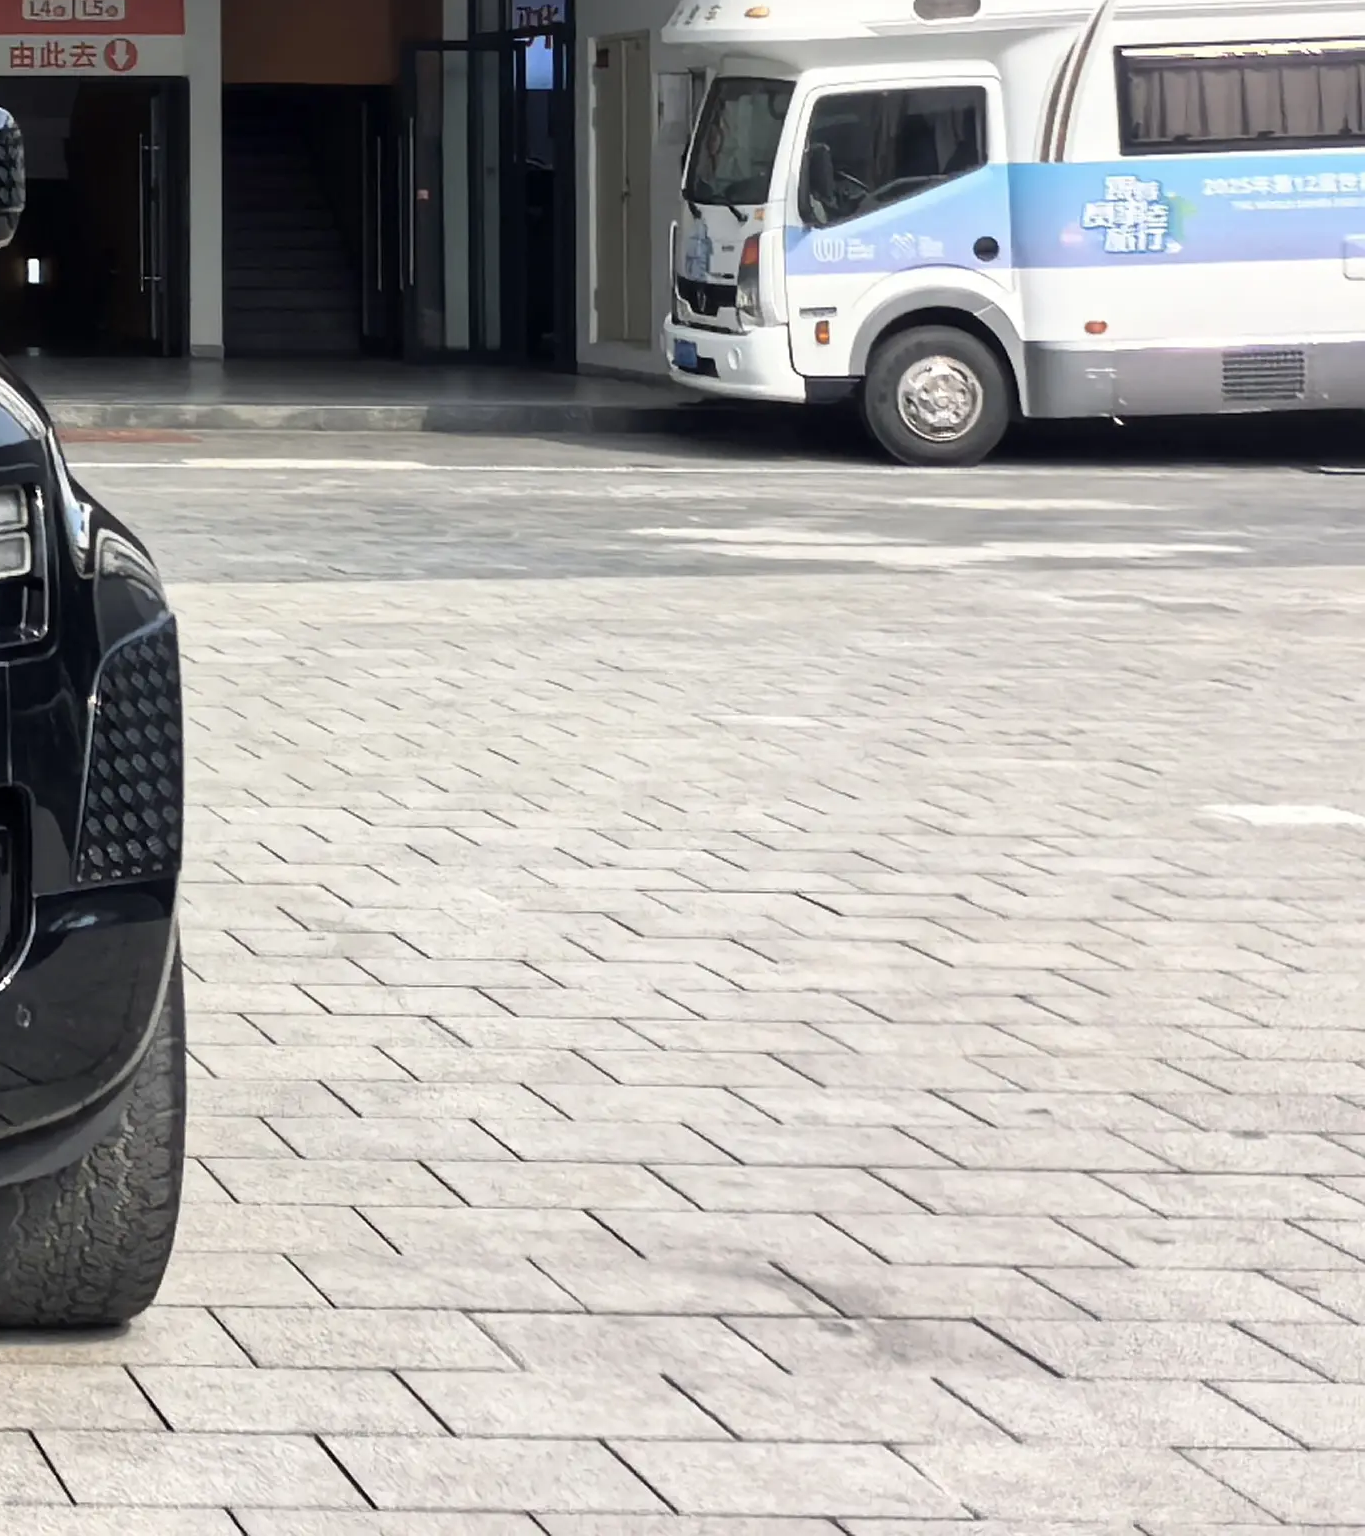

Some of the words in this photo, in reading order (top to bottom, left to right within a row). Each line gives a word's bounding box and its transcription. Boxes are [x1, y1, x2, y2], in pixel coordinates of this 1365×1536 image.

[29, 0, 52, 16] L4
[82, 0, 104, 16] L5
[9, 40, 98, 69] 由此去
